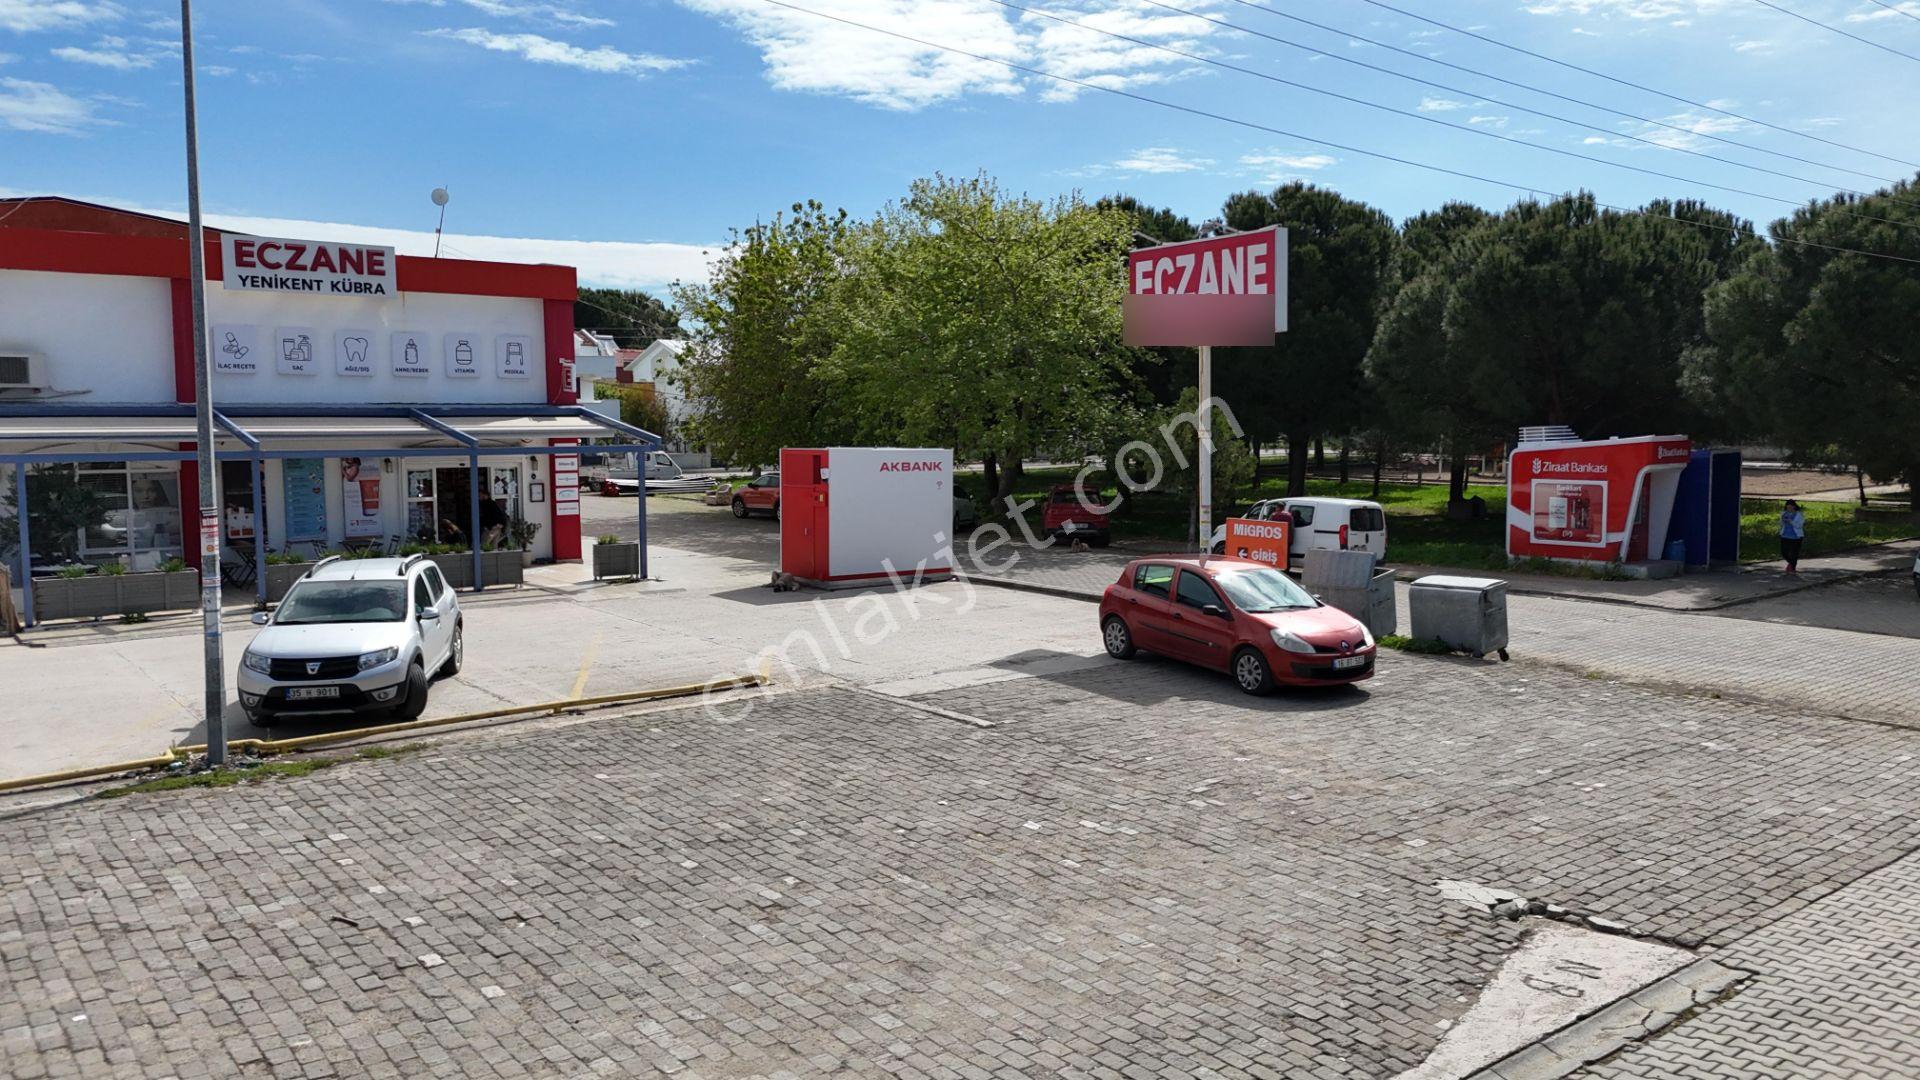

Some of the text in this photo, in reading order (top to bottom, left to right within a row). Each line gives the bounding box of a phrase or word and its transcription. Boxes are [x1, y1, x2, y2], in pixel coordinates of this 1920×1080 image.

[234, 239, 387, 276] ECZANE
[1135, 243, 1267, 294] ECZANE
[238, 274, 385, 295] YENİKENT KÜBRA
[880, 461, 943, 472] AKBANK
[1542, 462, 1608, 473] Ziraat Bankası
[1233, 523, 1282, 540] MiGROS
[1251, 548, 1278, 565] GİRİŞ
